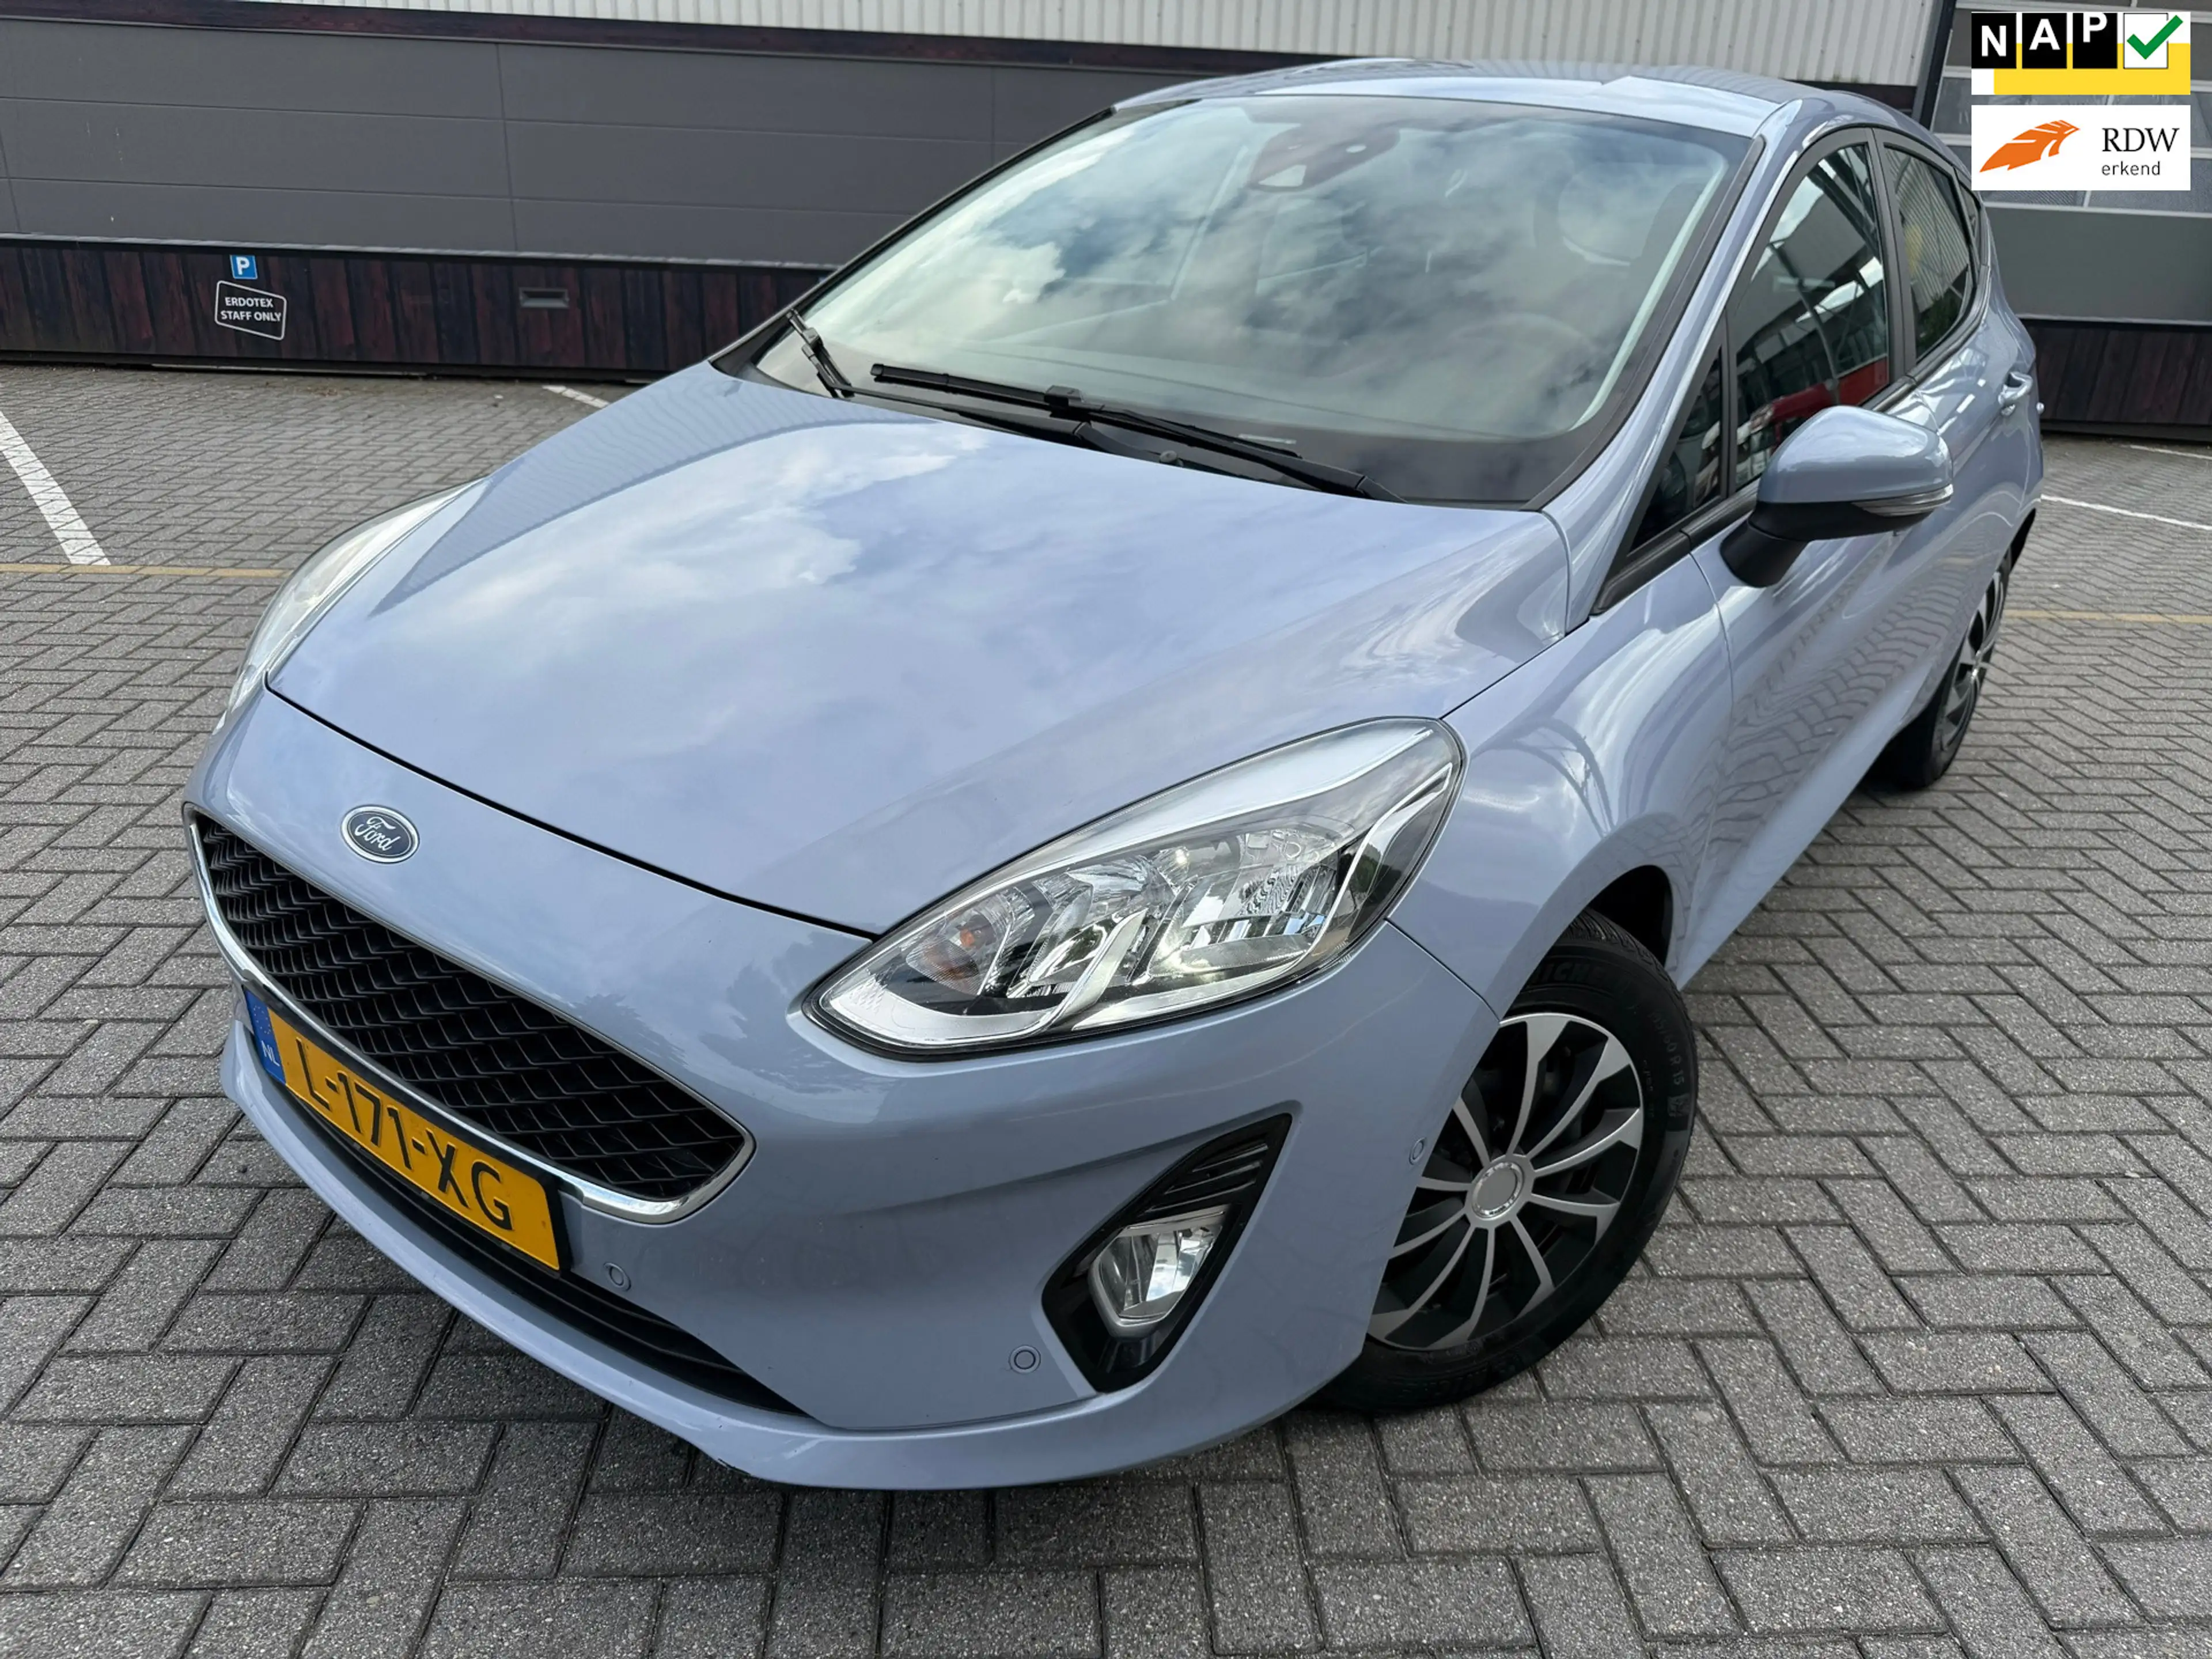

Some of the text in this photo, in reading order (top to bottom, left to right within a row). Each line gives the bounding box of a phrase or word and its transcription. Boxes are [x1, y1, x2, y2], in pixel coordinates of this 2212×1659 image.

[236, 256, 251, 275] P
[225, 297, 274, 308] ERDOTEX
[220, 310, 282, 322] STAFF ONLY
[354, 816, 402, 851] Ford
[260, 1040, 280, 1067] NL
[296, 1037, 515, 1232] L-171-XG
